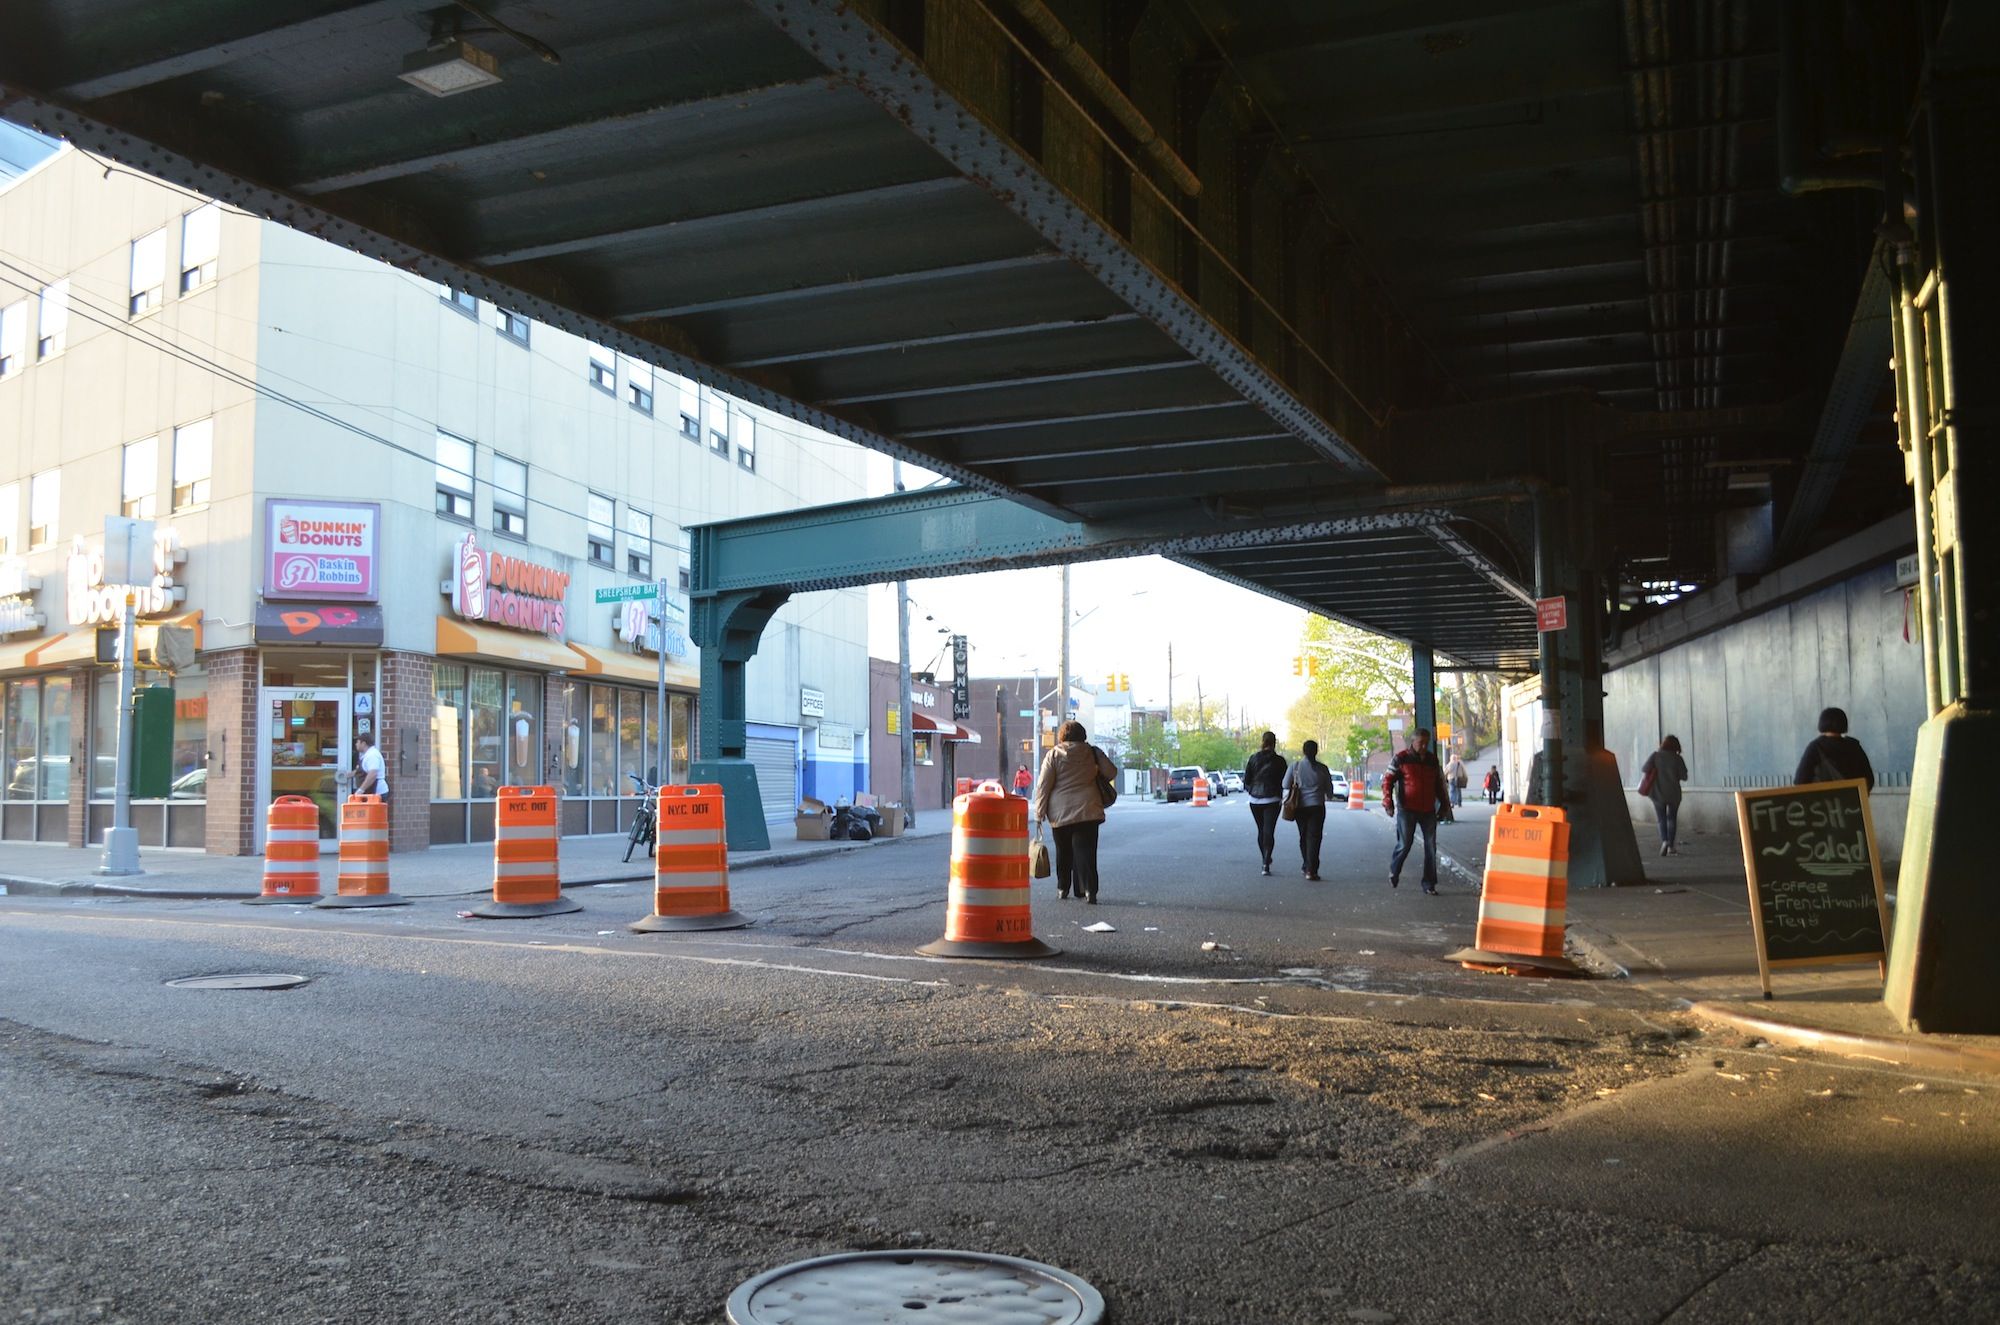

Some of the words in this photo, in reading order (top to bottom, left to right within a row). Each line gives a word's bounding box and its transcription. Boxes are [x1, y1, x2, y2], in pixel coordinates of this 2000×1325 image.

[301, 520, 366, 534] DUNKIN'
[301, 534, 363, 547] DONUTS
[319, 559, 355, 571] Baskin
[319, 571, 361, 583] Robbins
[490, 552, 570, 602] DUNKIN'
[598, 585, 641, 599] SHEEPSHEAD
[643, 584, 656, 594] BAY
[488, 588, 566, 635] DONUTS
[956, 639, 967, 701] TOWNE
[357, 695, 369, 708] A
[803, 697, 823, 710] OFFICES
[692, 803, 709, 815] DOT
[1795, 830, 1866, 863] Salad
[1775, 914, 1806, 928] Tea
